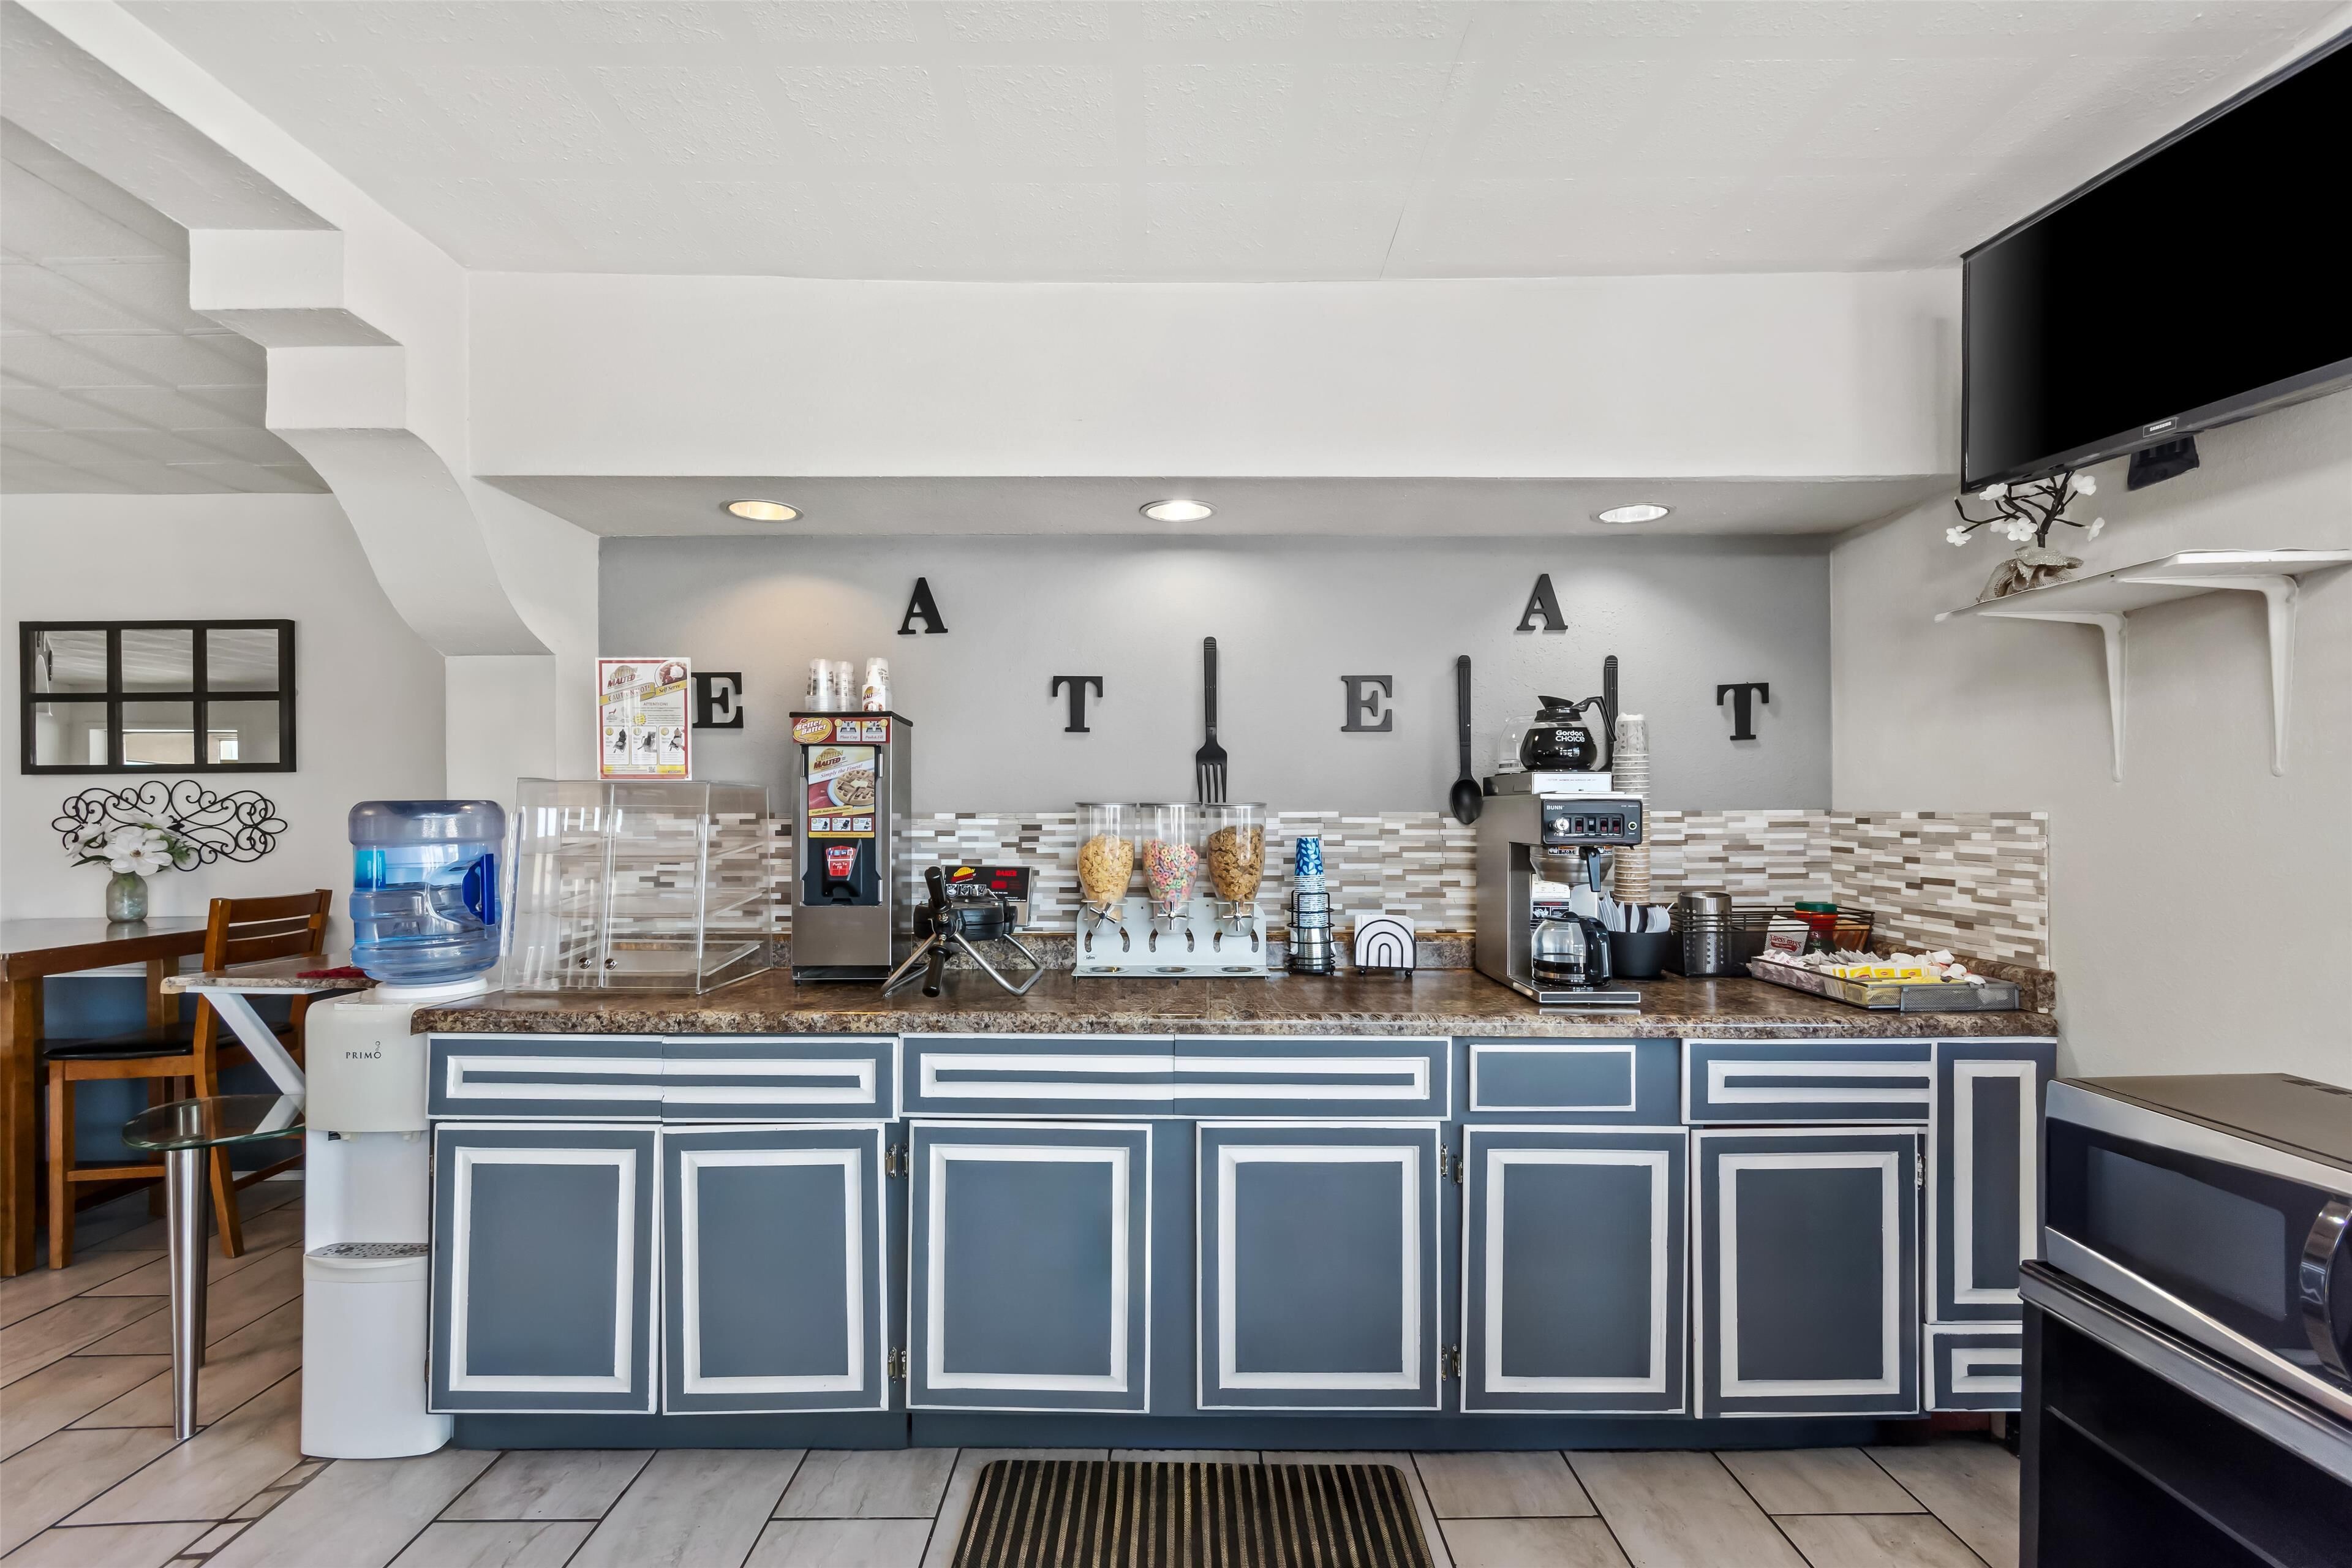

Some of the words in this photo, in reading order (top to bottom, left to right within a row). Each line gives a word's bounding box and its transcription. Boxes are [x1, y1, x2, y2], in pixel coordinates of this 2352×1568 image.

[608, 690, 635, 701] CAUTN
[796, 718, 823, 731] Better
[801, 723, 827, 736] Batter
[813, 756, 841, 769] MALTED
[820, 769, 837, 778] Simply
[846, 763, 863, 772] Finest!
